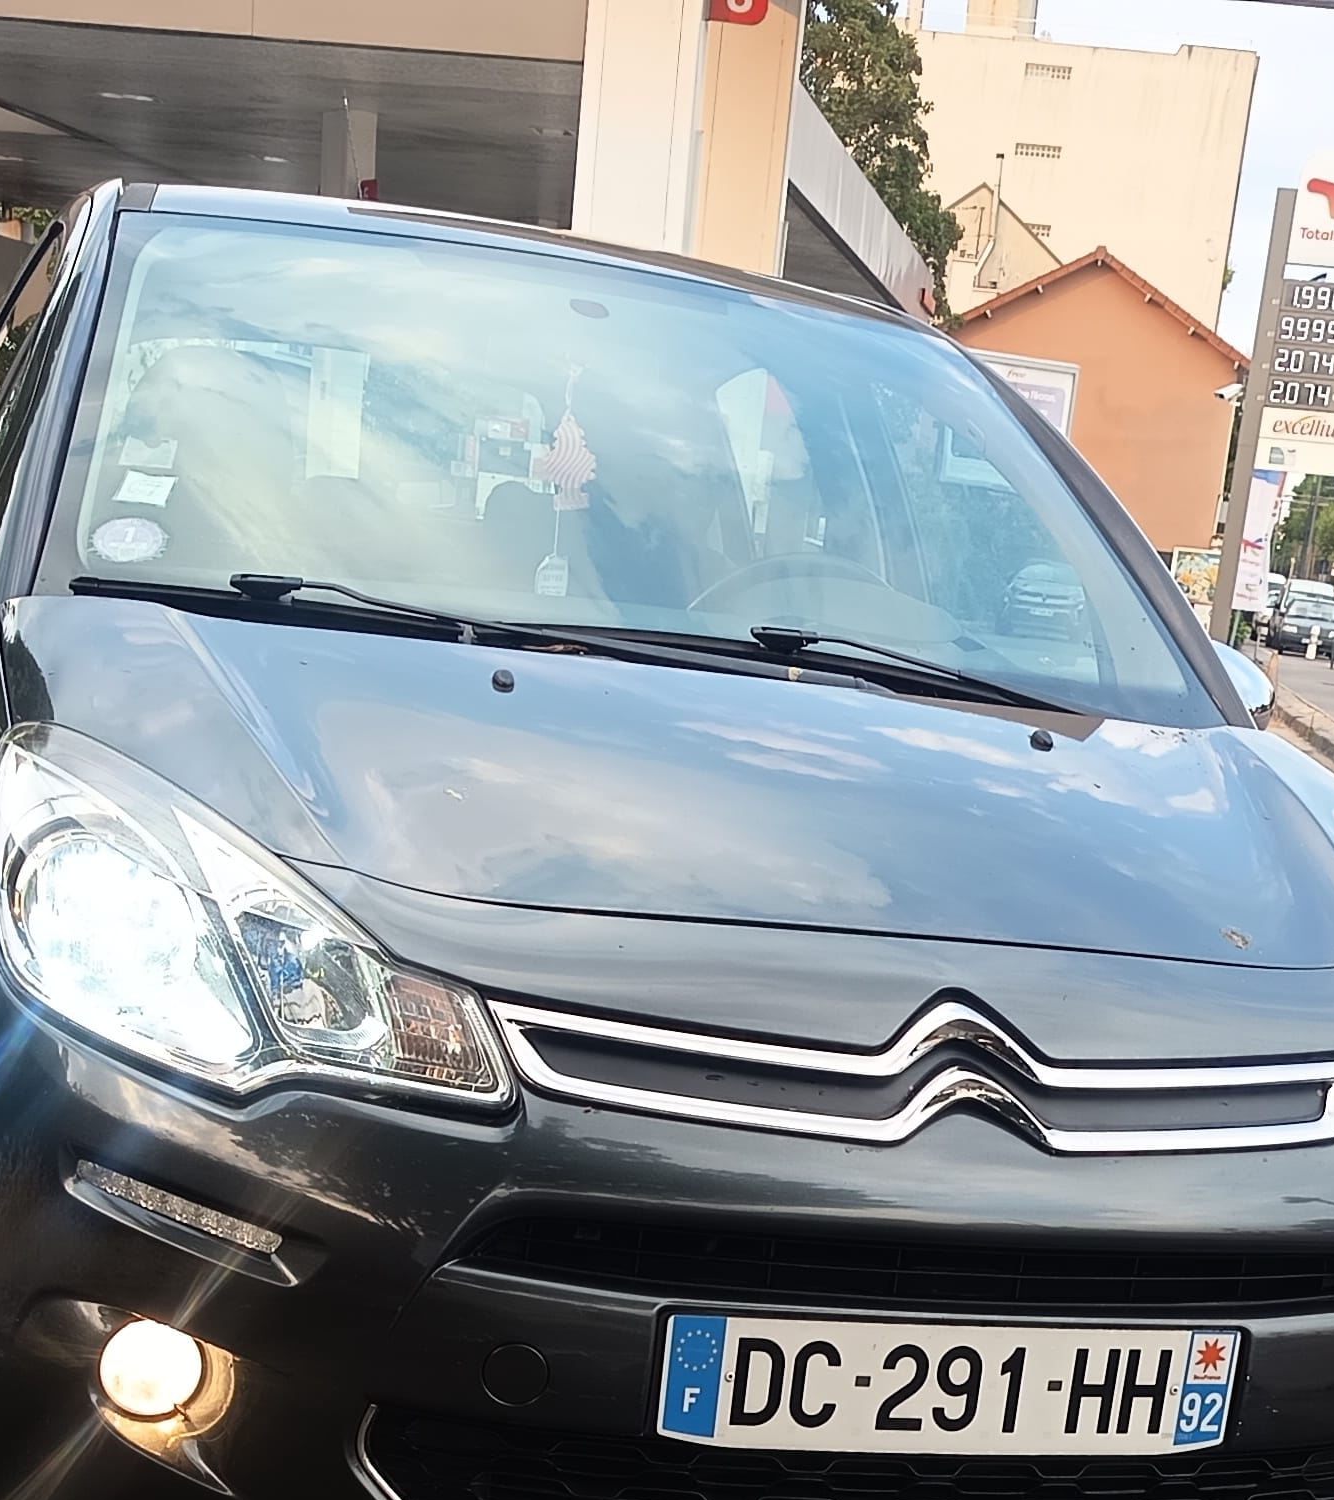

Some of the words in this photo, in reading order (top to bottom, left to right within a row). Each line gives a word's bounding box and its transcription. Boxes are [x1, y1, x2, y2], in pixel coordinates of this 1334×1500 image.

[1269, 380, 1331, 407] 2.074
[682, 1387, 701, 1413] F
[729, 1337, 1173, 1434] DC-291-HH
[1179, 1391, 1223, 1433] 92
